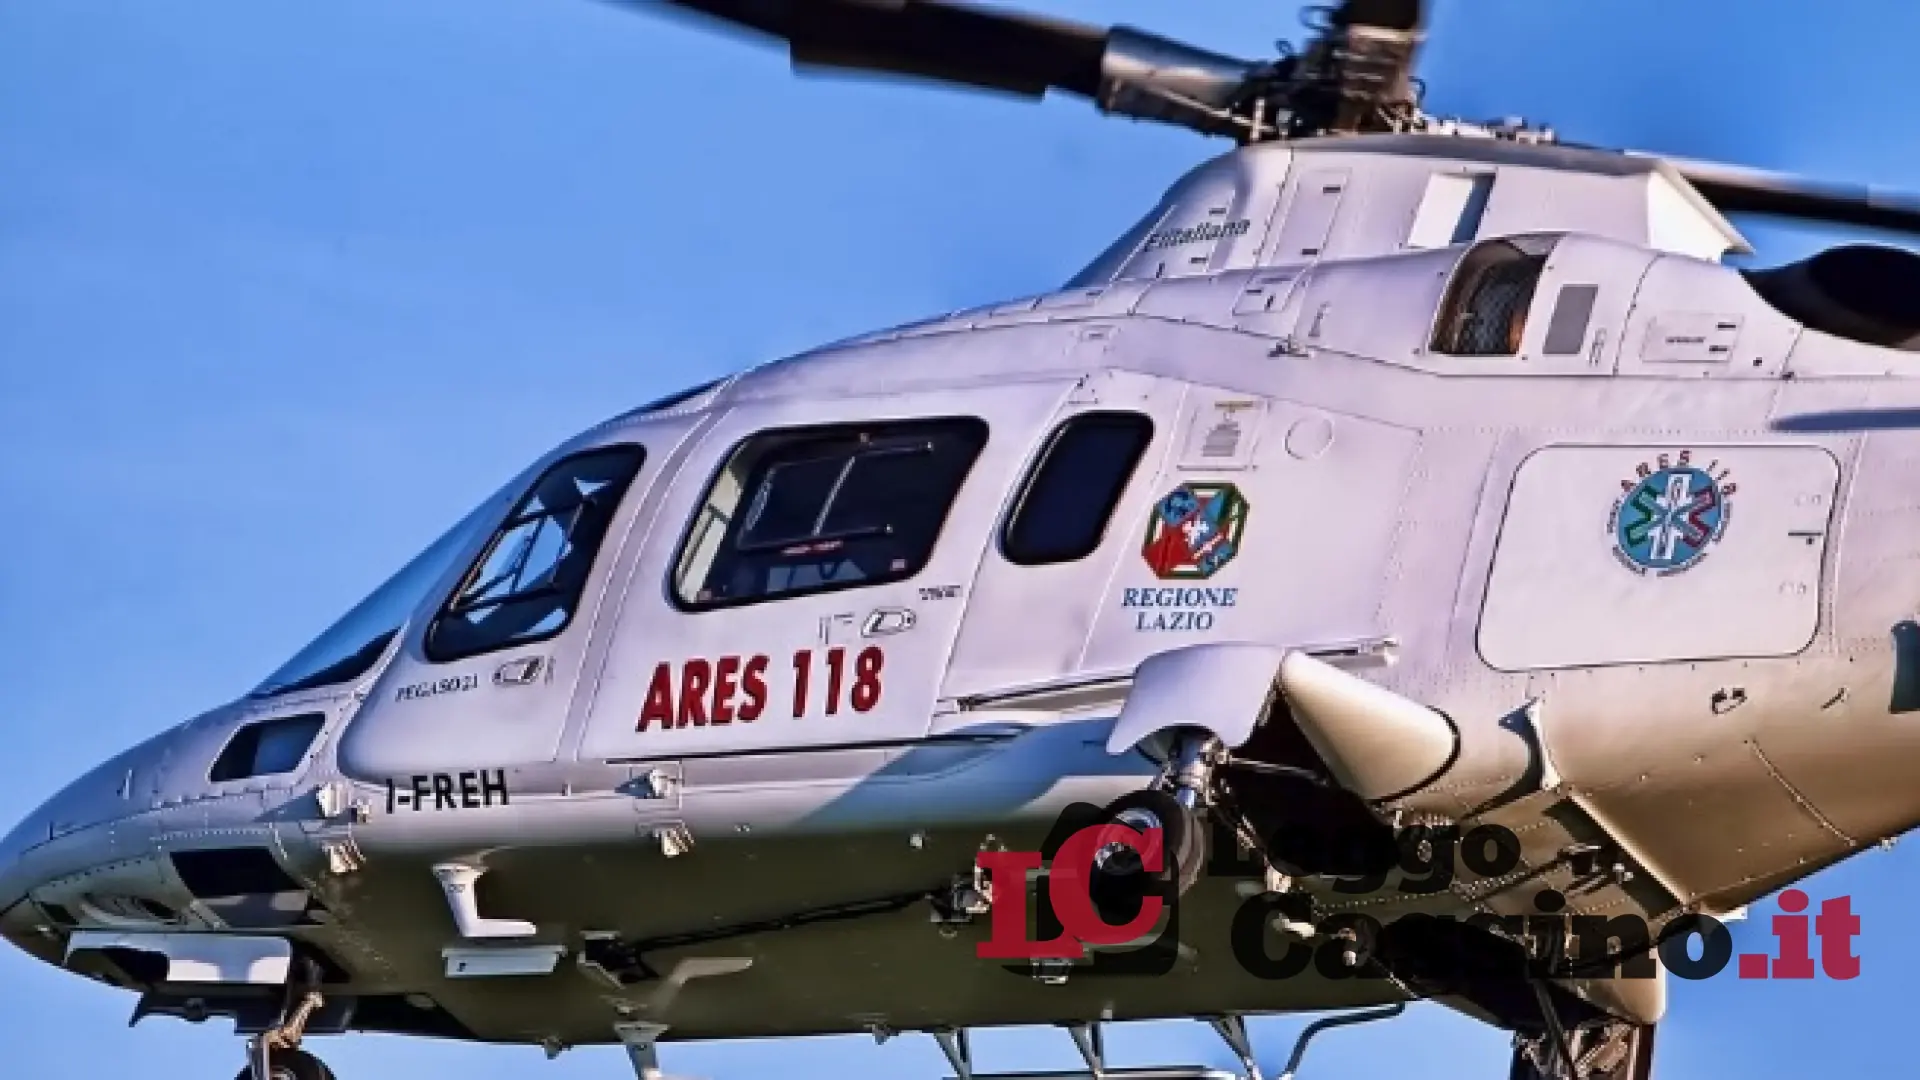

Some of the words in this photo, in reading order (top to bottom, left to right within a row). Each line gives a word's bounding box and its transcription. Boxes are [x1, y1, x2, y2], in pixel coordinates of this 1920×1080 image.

[1621, 450, 1692, 492] ARES
[1121, 588, 1238, 607] REGIONE
[1135, 611, 1214, 631] LAZIO
[635, 654, 770, 733] ARES
[792, 645, 884, 720] 118
[385, 769, 510, 814] I-FREH
